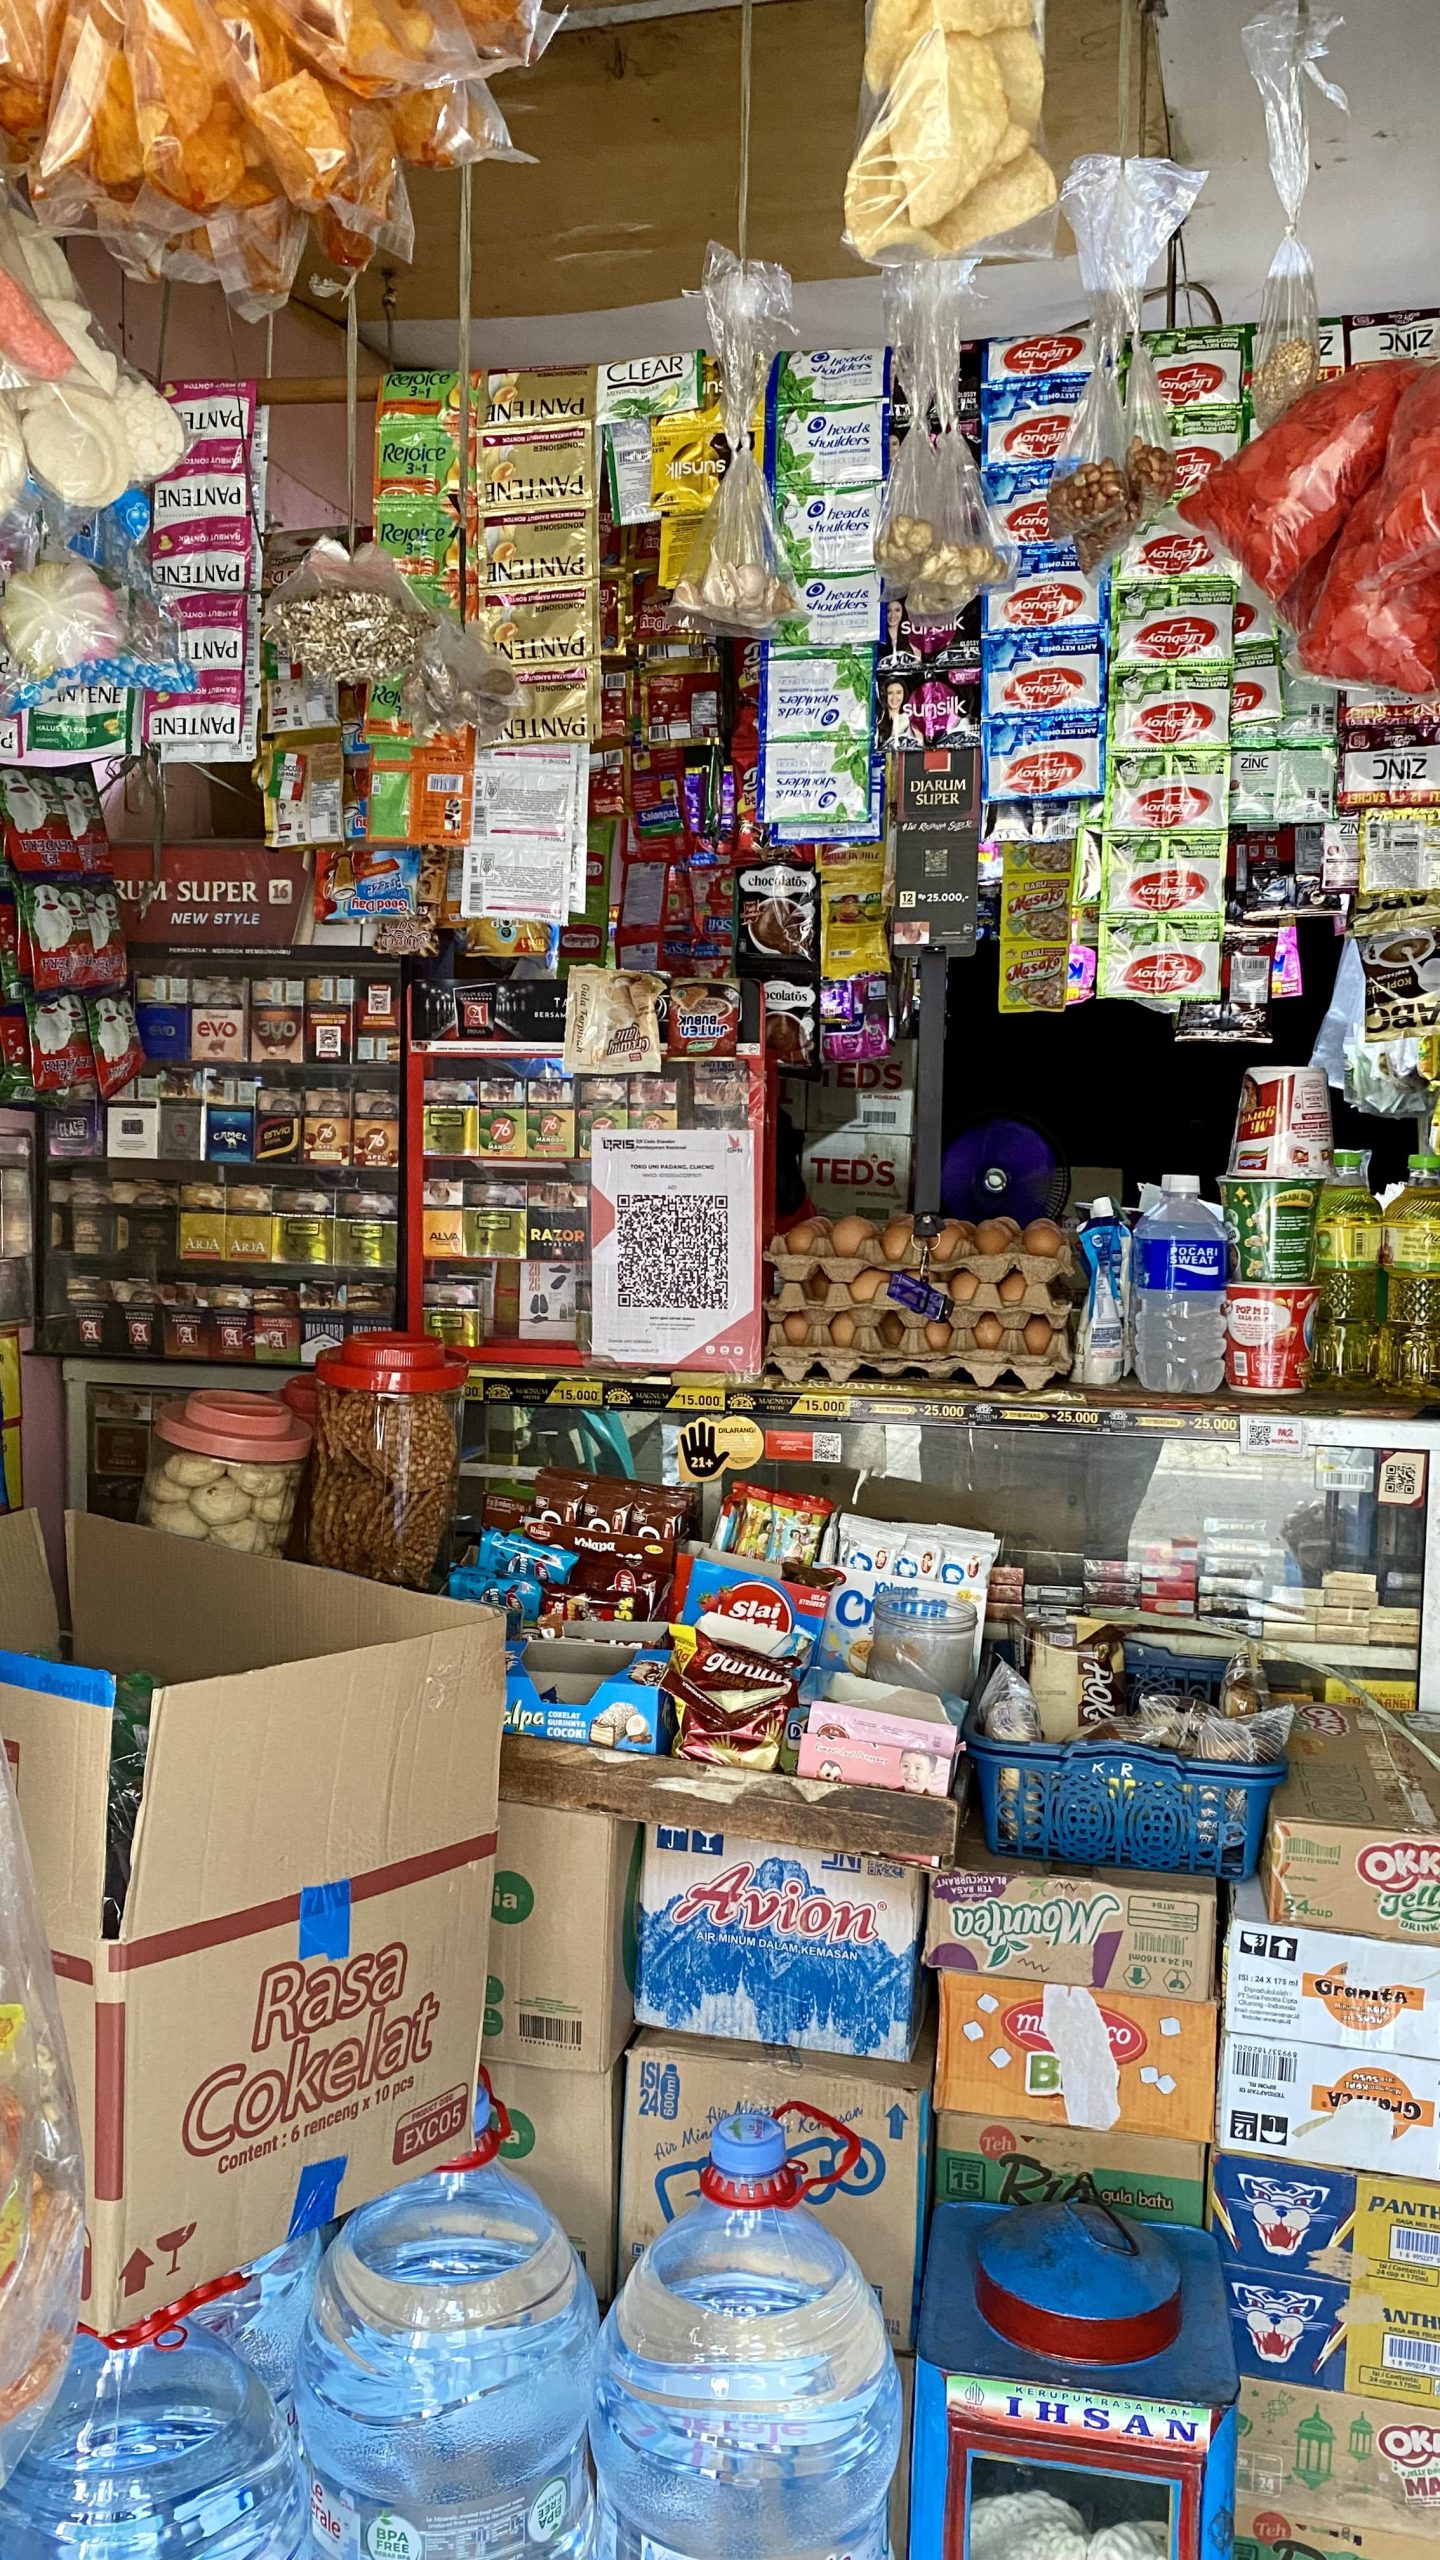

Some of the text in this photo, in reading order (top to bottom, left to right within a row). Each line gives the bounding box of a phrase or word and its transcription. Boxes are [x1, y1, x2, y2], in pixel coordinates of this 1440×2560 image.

[1378, 327, 1432, 354] ZINC
[1013, 345, 1075, 362] Lifebuoy
[605, 354, 684, 383] CLEAR
[385, 370, 451, 389] Rejoice
[484, 396, 586, 424] PANTENE
[807, 434, 871, 450] shoulders
[382, 442, 447, 465] Rejoice
[664, 459, 727, 480] sunsilk
[157, 486, 242, 508] PANTENE
[379, 522, 446, 544] Rejoice
[533, 521, 585, 533] KONDISIONER
[806, 519, 870, 534] shoulders
[155, 563, 240, 585] PANTENE
[534, 602, 585, 613] KONDISIONER
[805, 599, 869, 612] shoulders
[1013, 596, 1074, 615] Lifebuoy
[1038, 639, 1099, 654] ANTI KETOMBE
[901, 695, 968, 719] sunsilk
[35, 724, 65, 735] HALUS
[152, 715, 236, 736] PANTENE
[1038, 723, 1099, 738] ANTI KETOMBE
[1240, 756, 1270, 770] ZINC
[1371, 757, 1428, 781] ZINC
[909, 778, 967, 793] DJARUM
[915, 791, 960, 806] SUPER
[1346, 792, 1388, 806] SACHET
[640, 808, 680, 824] Salonpas
[20, 837, 78, 854] BENDERA
[176, 879, 290, 903] SUPER 16
[1023, 879, 1048, 890] BARU
[901, 892, 914, 904] 12
[926, 891, 970, 903] 25.000,-
[1007, 887, 1066, 916] Masako
[351, 897, 408, 914] Good Day
[170, 911, 261, 927] NEW STYLE
[211, 947, 244, 955] MEROKOK
[1021, 948, 1045, 960] BARU
[1005, 954, 1061, 982] Masako
[1388, 976, 1413, 993] KOPI
[466, 1002, 487, 1027] A
[574, 983, 591, 1054] Gula Terpisah
[676, 1013, 718, 1028] BUBUK
[196, 1019, 238, 1039] evo
[606, 1035, 652, 1056] Creamy
[494, 1121, 512, 1138] 76
[540, 1115, 557, 1131] 76
[212, 1131, 248, 1143] CAMEL
[535, 1136, 565, 1144] MANGGA
[602, 1138, 637, 1152] QRIS
[366, 1153, 388, 1161] APEL
[428, 1230, 460, 1243] ALVA
[529, 1227, 586, 1243] RAZOR
[183, 1238, 220, 1252] ARJA
[229, 1239, 266, 1254] ARJA
[1169, 1246, 1219, 1258] POCARI
[1169, 1254, 1215, 1266] SWEAT
[514, 1387, 549, 1397] MAGNUM
[558, 1388, 599, 1403] 15.000
[634, 1391, 670, 1402] MAGNUM
[680, 1393, 721, 1408] 15.000
[757, 1397, 793, 1408] MAGNUM
[804, 1399, 846, 1412] 15.000
[923, 1403, 965, 1419] 25.000
[1056, 1410, 1099, 1425] 25.000
[717, 1426, 757, 1436] DILARANG!
[1193, 1416, 1238, 1431] 25.000
[690, 1456, 714, 1469] 21+
[529, 1526, 552, 1539] Roma
[728, 1598, 781, 1620] Slai
[547, 1710, 581, 1720] COKELAT
[546, 1727, 587, 1740] COCOK!
[934, 1873, 1007, 1889] BLACKCURRANT
[974, 1885, 994, 1896] TEH
[671, 1861, 878, 1944] Avion
[1150, 1900, 1176, 1911] MTB4
[1309, 1903, 1334, 1919] cup
[953, 1893, 1121, 1947] Mountea
[1399, 1920, 1440, 1933] DRINK
[695, 1930, 860, 1961] AIR MINUM DALAM KEMASAN
[1127, 1951, 1160, 1966] 160ml
[1237, 1973, 1299, 1987] ISI 24 175 ml
[252, 1940, 409, 2053] Rasa
[1355, 2013, 1384, 2025] SUSU
[181, 1992, 441, 2158] Cokelat
[640, 2059, 661, 2089] ISI
[1351, 2072, 1380, 2083] SUSU
[1344, 2081, 1369, 2091] KOPI
[638, 2088, 660, 2117] 24
[662, 2074, 677, 2118] 600ml
[217, 2073, 416, 2175] Content 6 renceng 10 pcs
[1233, 2122, 1254, 2139] 12
[981, 2133, 1016, 2152] Teh
[652, 2141, 678, 2161] Air
[952, 2170, 981, 2193] 15
[1101, 2189, 1174, 2211] gula batu
[1405, 2272, 1430, 2283] 170ml
[1014, 2385, 1192, 2419] KERUPUK RASA IKAN
[1004, 2395, 1199, 2444] IHSAN
[375, 2527, 409, 2544] BPA
[1255, 2520, 1288, 2536] Teh
[375, 2540, 410, 2555] FREE
